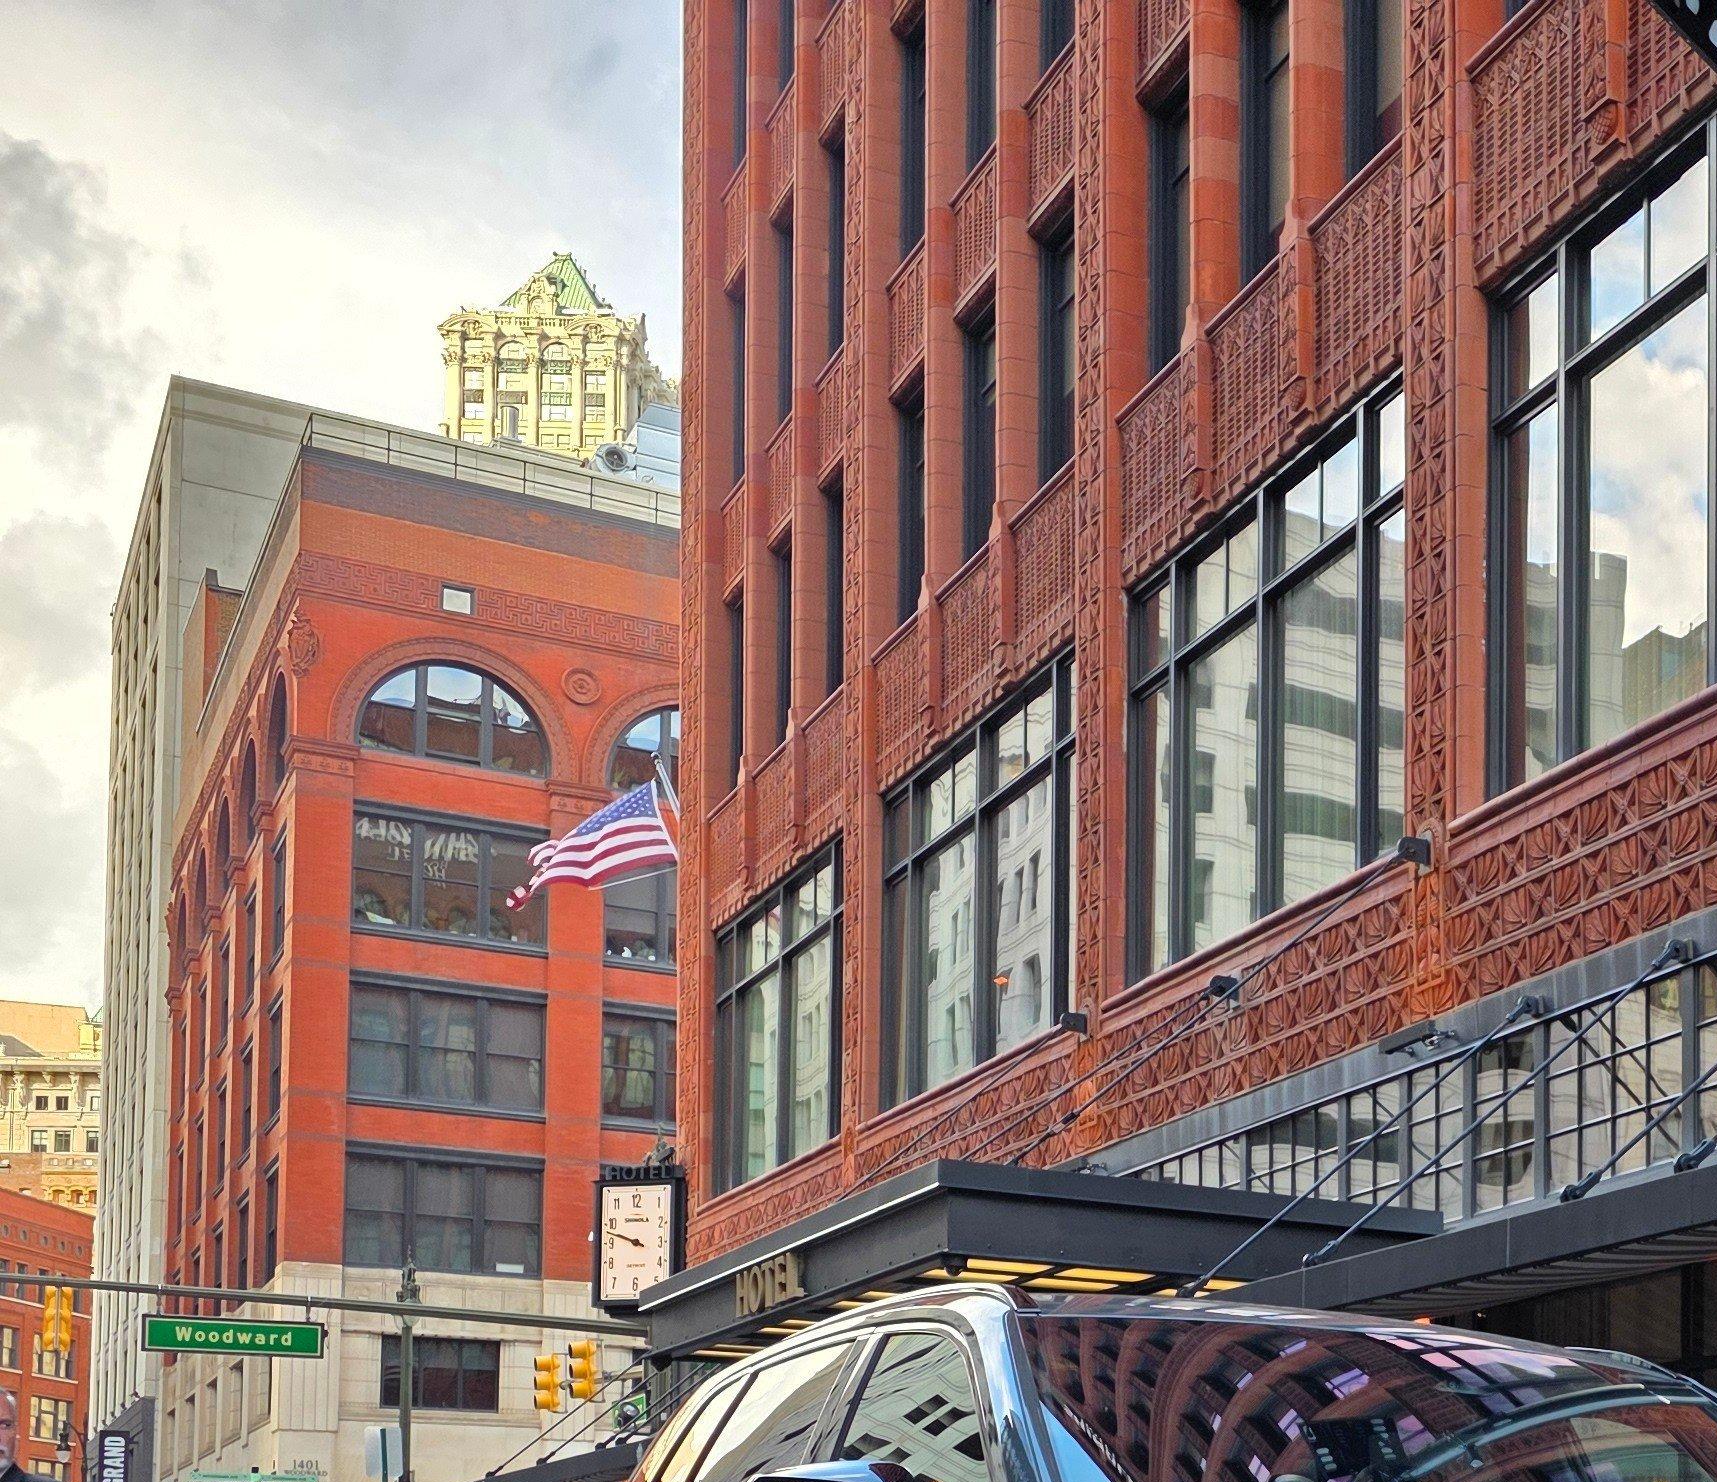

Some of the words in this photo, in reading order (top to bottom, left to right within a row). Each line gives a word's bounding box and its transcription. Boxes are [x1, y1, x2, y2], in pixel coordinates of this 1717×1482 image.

[605, 1165, 672, 1180] HOTEL
[613, 1198, 620, 1210] 11
[632, 1193, 642, 1208] 12
[657, 1196, 661, 1208] 1
[608, 1217, 617, 1230] 10
[658, 1216, 663, 1228] 2
[608, 1237, 614, 1250] 9
[657, 1236, 663, 1249] 3
[608, 1257, 614, 1270] 8
[656, 1255, 663, 1268] 4
[611, 1276, 617, 1290] 7
[632, 1276, 639, 1291] 6
[735, 1252, 805, 1317] HOTEL
[175, 1326, 293, 1346] Woodward
[293, 1459, 319, 1470] 1401
